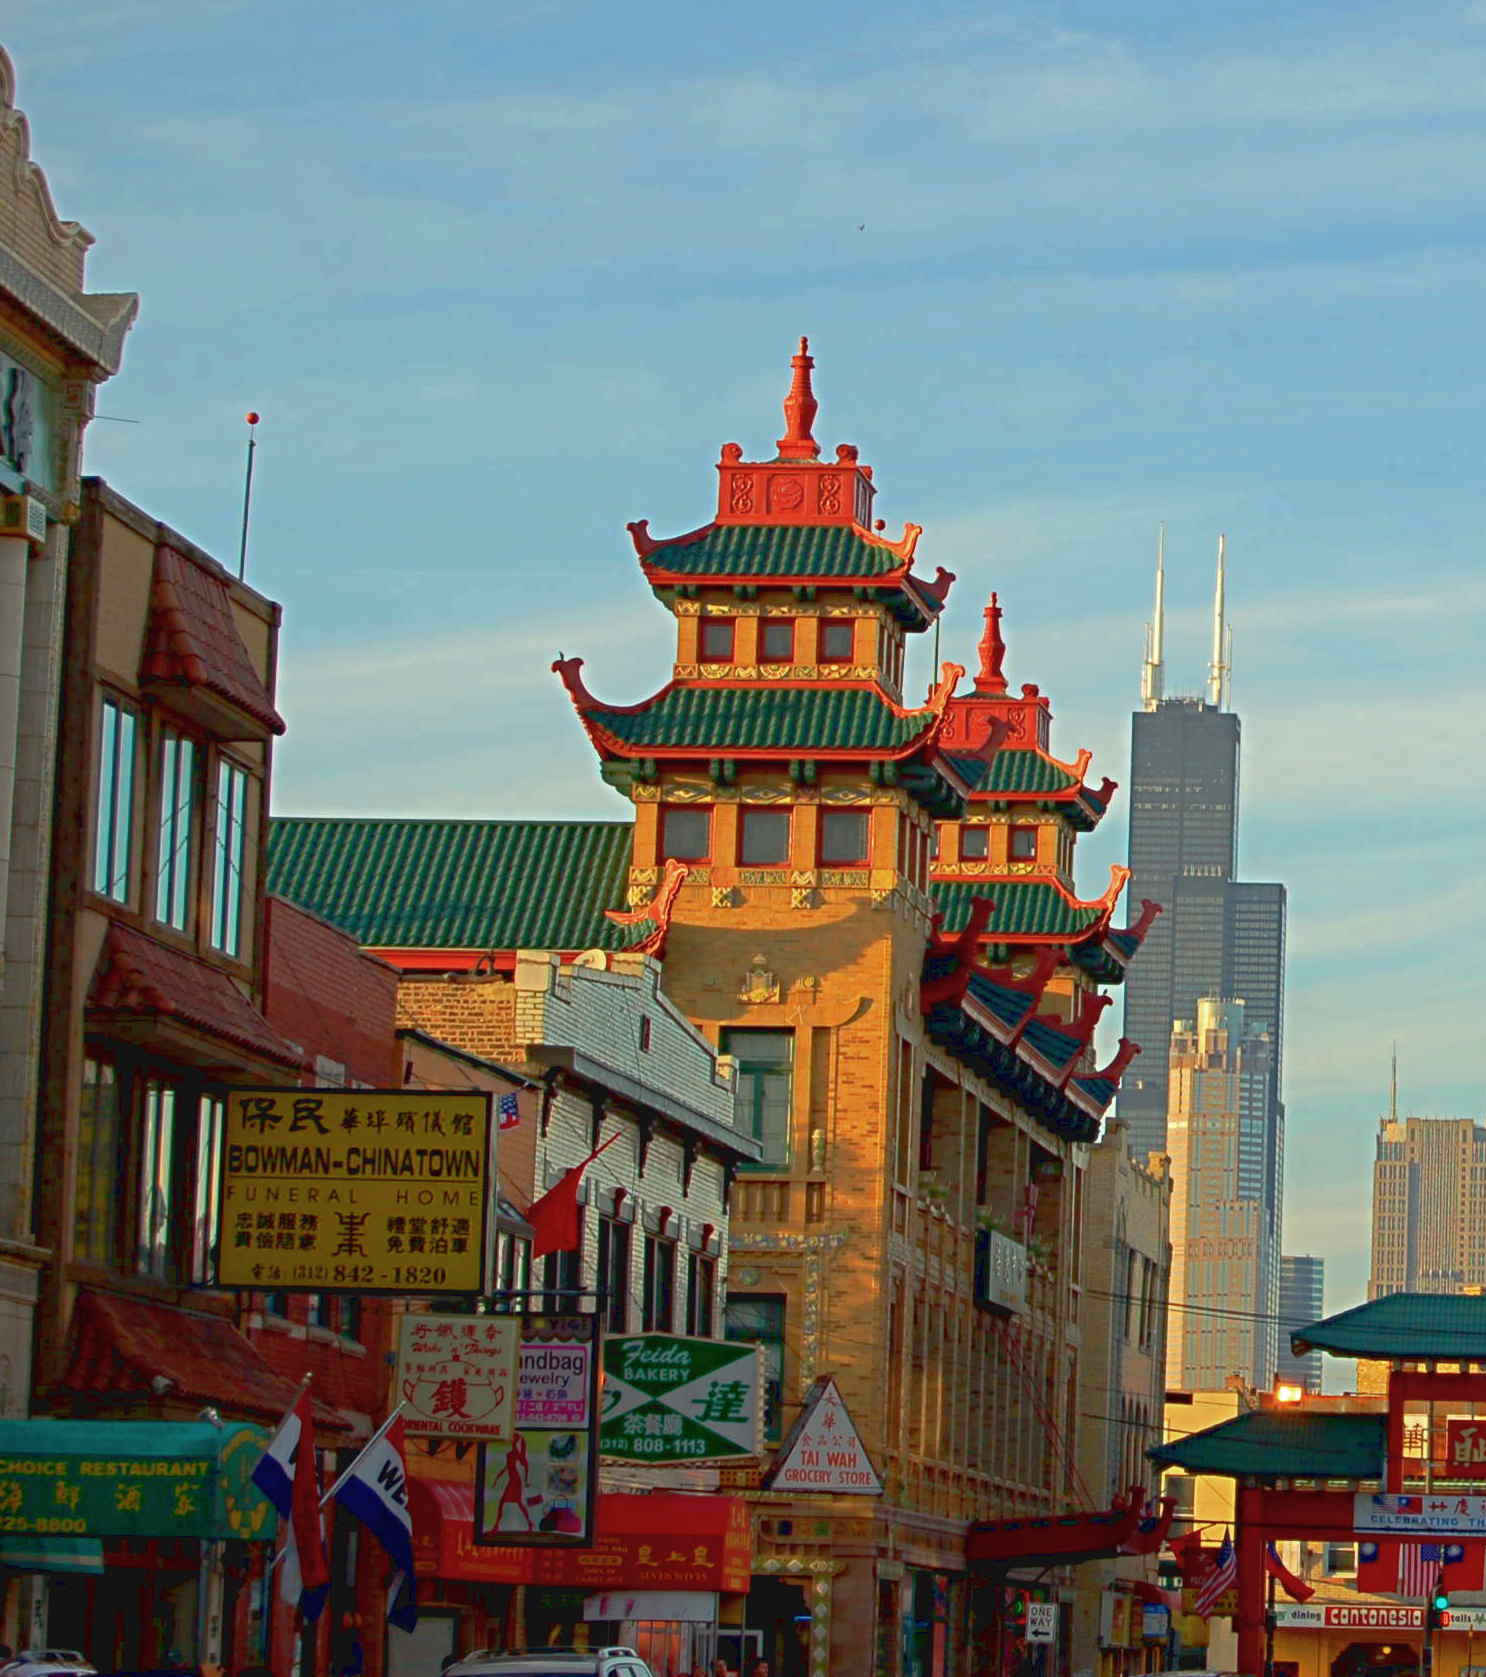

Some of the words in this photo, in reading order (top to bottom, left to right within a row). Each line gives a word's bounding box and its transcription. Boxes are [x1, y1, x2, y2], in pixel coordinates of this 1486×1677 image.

[239, 1096, 331, 1135] 保民
[227, 1144, 481, 1178] BOWMAN-CHINATOWN
[227, 1186, 361, 1205] FUNERAL
[396, 1189, 480, 1207] HOME
[621, 1340, 692, 1367] Feida
[520, 1372, 571, 1388] ewelry
[623, 1368, 691, 1382] BAKERY
[633, 1437, 706, 1455] 808-1113
[79, 1461, 209, 1476] RESTAURANT
[801, 1453, 819, 1467] TAI
[826, 1453, 857, 1469] WAH
[785, 1468, 831, 1484] GROCERY
[839, 1469, 872, 1486] STORE
[1370, 1514, 1459, 1527] CELEBRATING
[1030, 1606, 1052, 1618] ONE
[1291, 1611, 1322, 1622] dining
[1331, 1607, 1422, 1627] cantonesia
[1029, 1618, 1053, 1628] WAY
